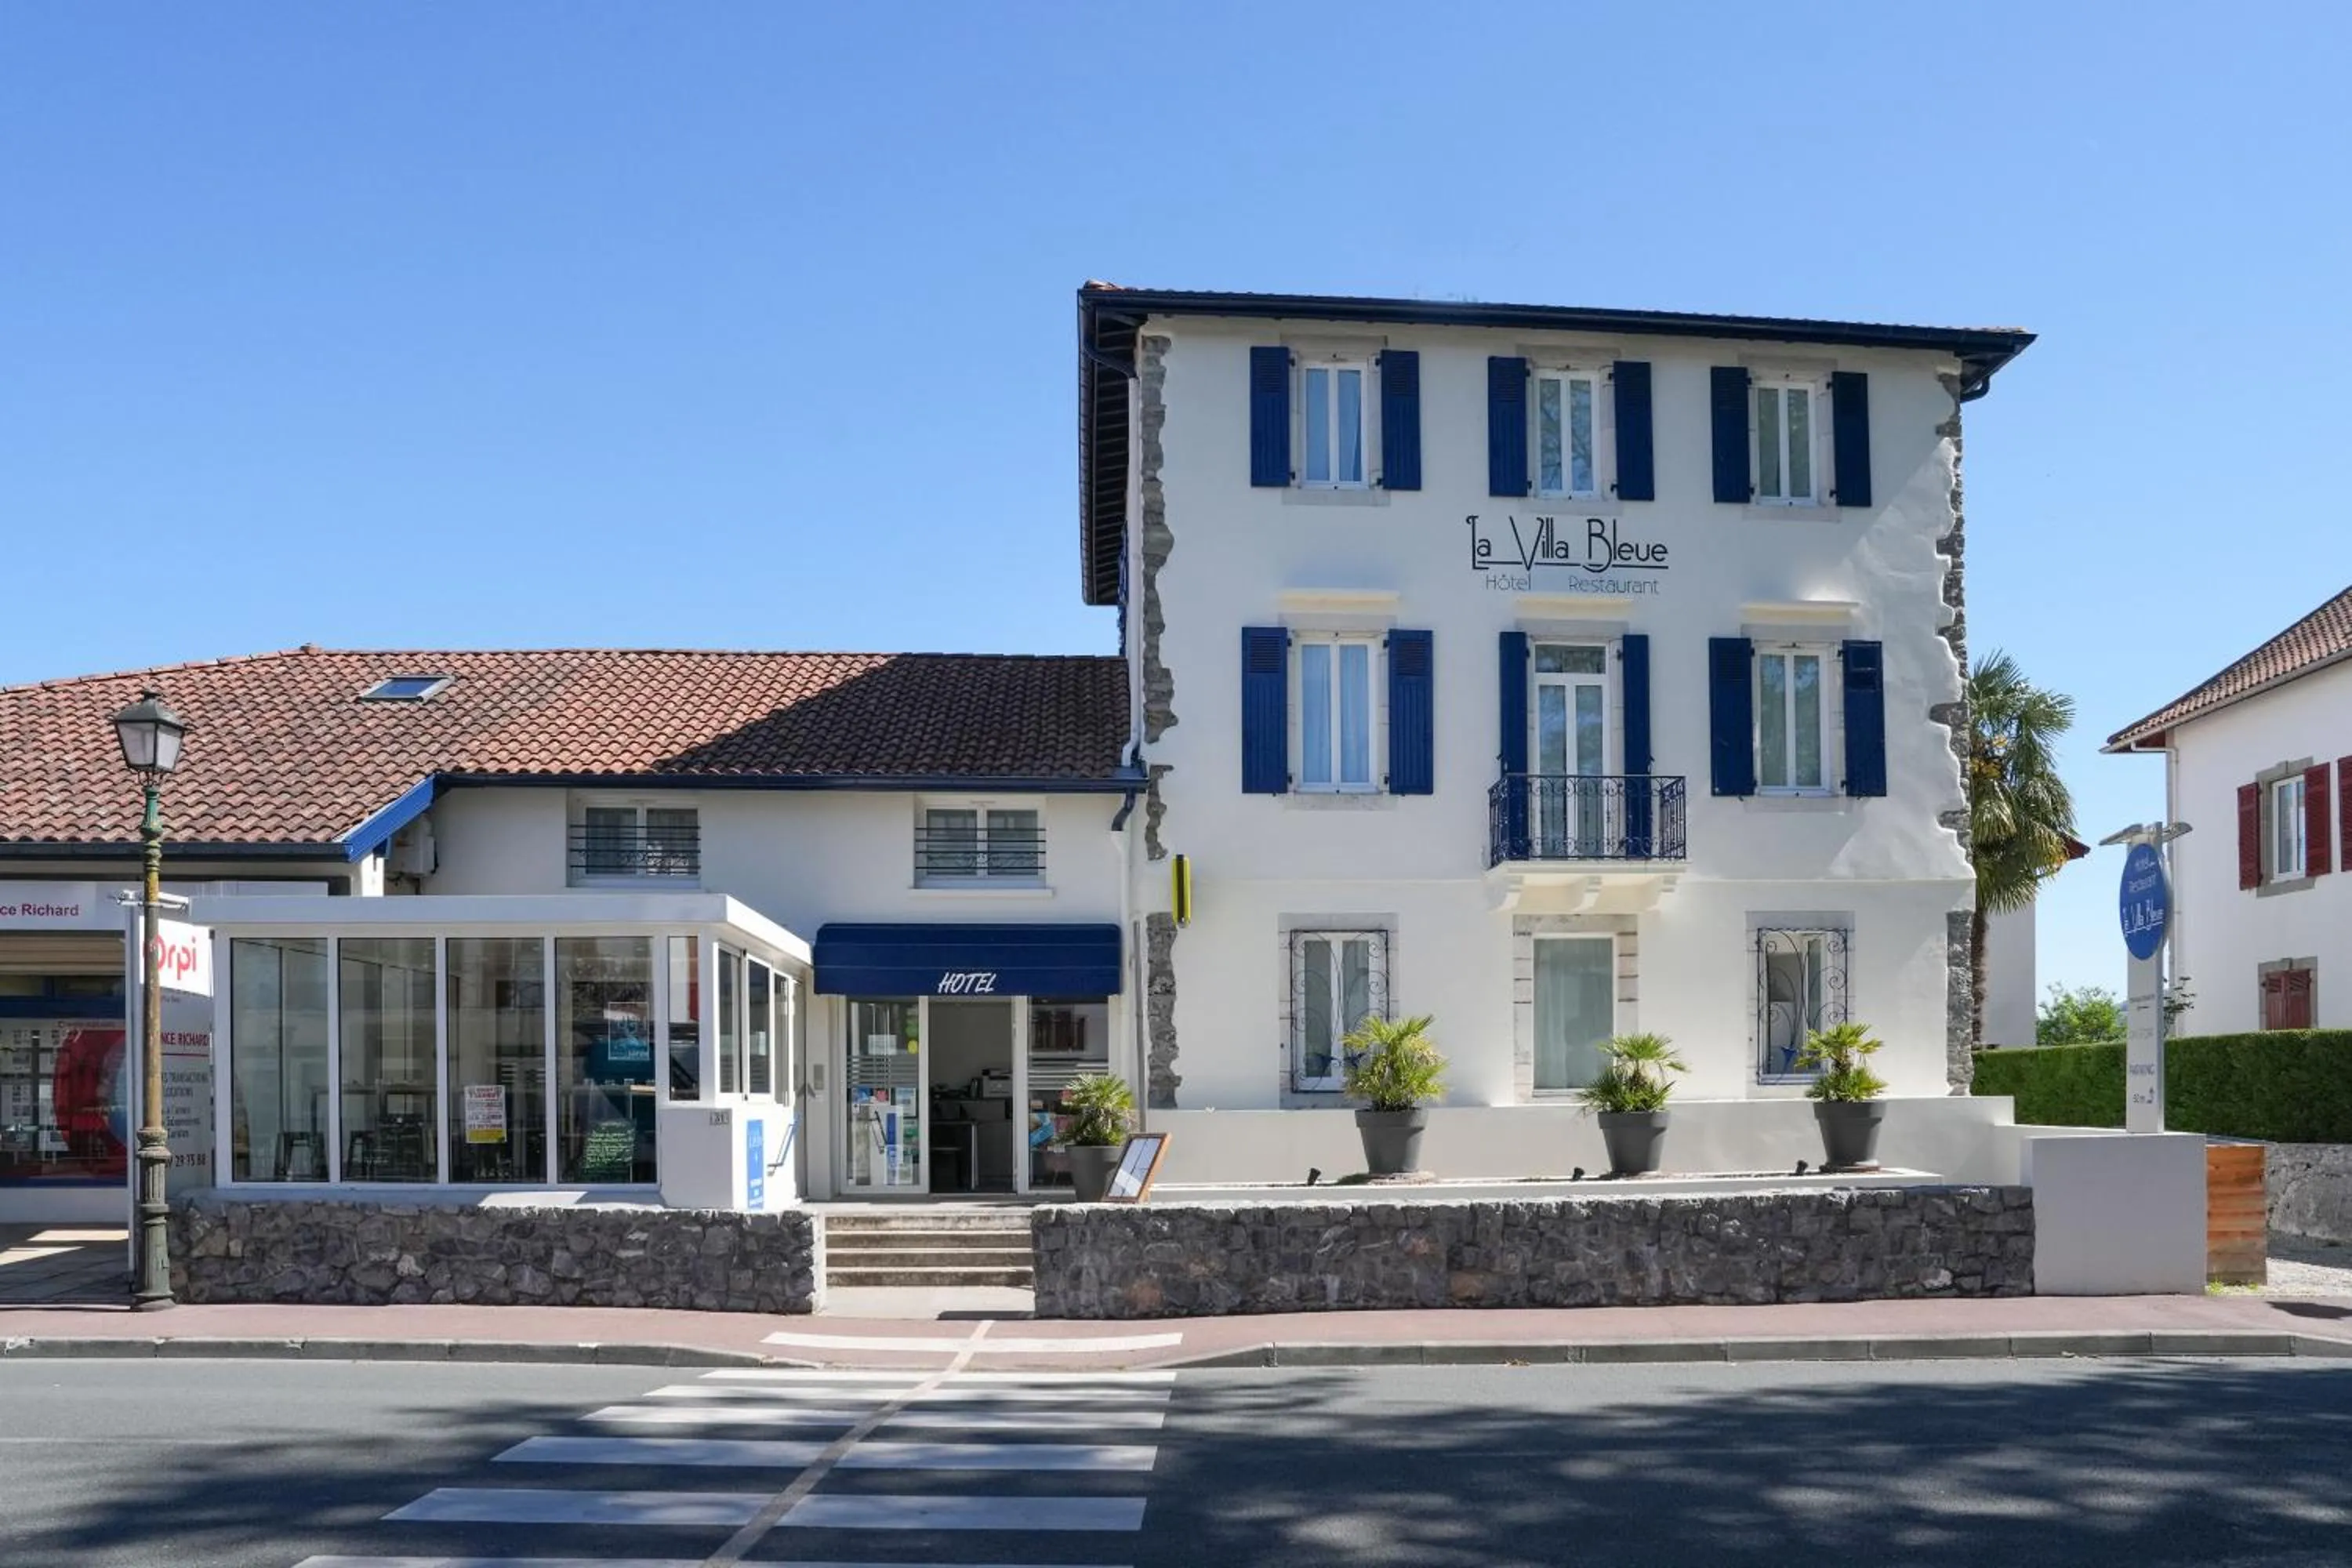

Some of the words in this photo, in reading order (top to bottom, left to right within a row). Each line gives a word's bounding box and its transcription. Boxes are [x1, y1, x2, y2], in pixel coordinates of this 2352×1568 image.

[1465, 514, 1490, 569] La
[1508, 515, 1569, 571] Villa
[1582, 517, 1669, 572] Bleue
[1485, 574, 1531, 590] Hôtel
[1568, 575, 1659, 594] Restaurant
[21, 903, 79, 916] Richard
[938, 972, 997, 994] HOTEL
[178, 1033, 209, 1047] RICHARD
